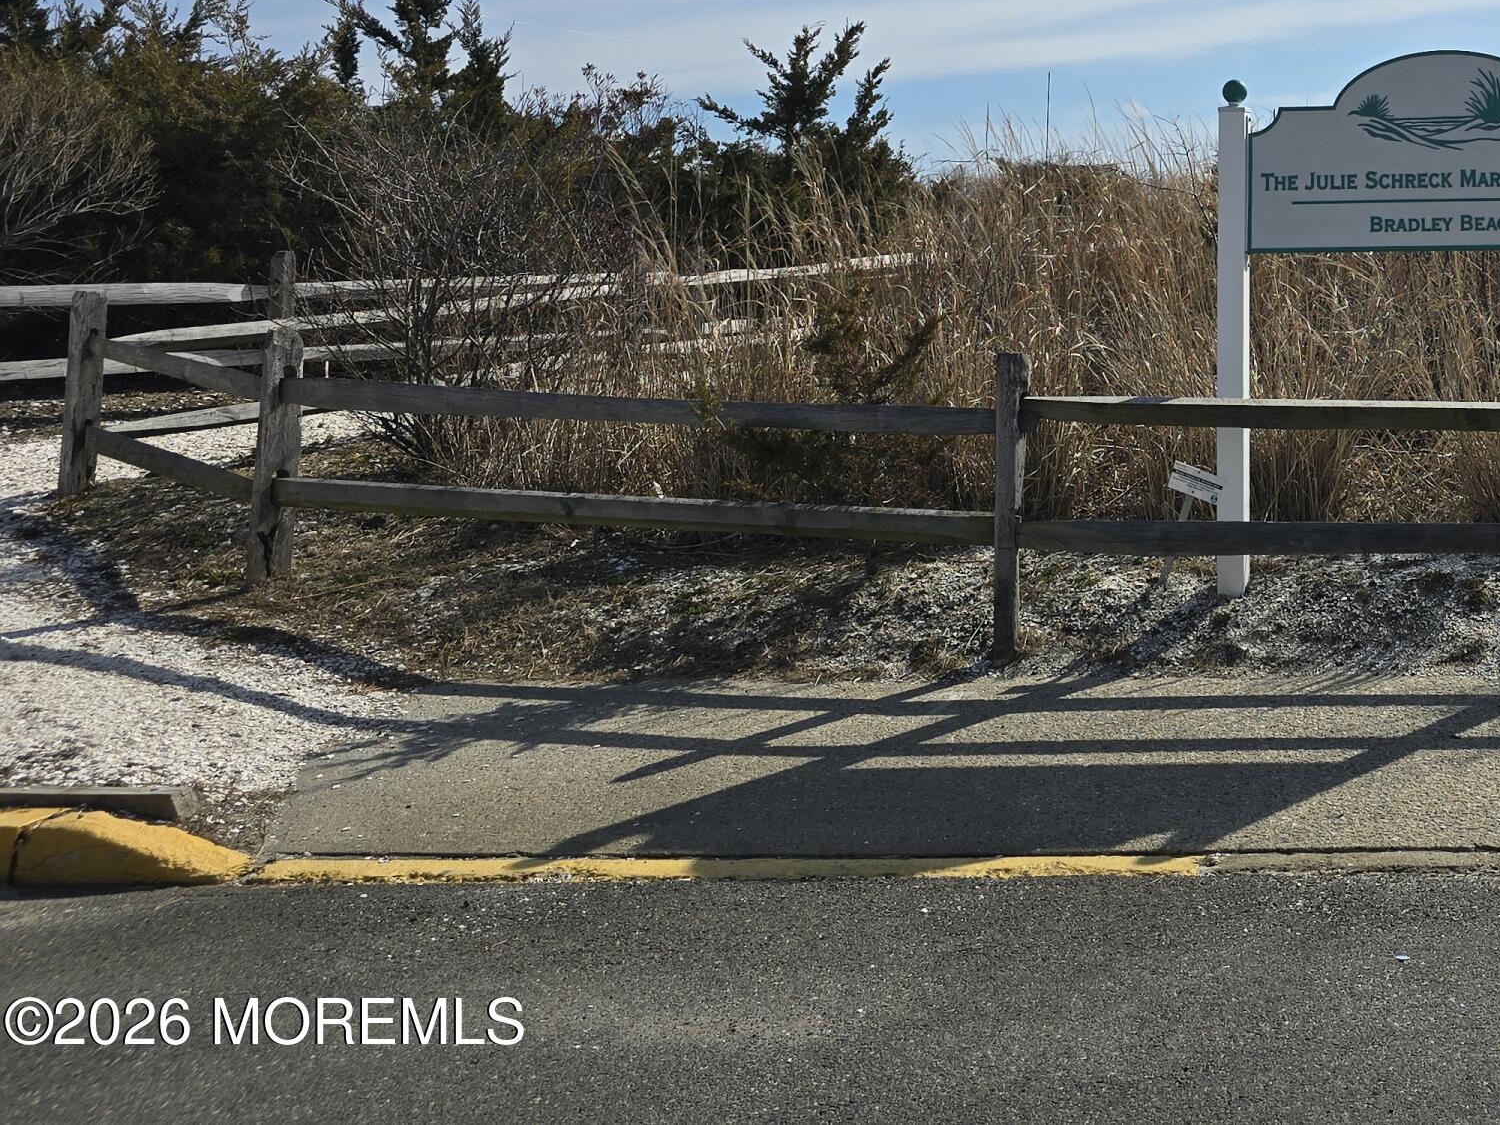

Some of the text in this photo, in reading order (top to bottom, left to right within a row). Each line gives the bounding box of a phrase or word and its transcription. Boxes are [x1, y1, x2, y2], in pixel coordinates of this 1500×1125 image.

[1261, 172, 1299, 191] THE
[1305, 172, 1358, 191] JULIE
[1365, 171, 1453, 189] SCHRECK
[1370, 216, 1453, 233] BRADLEY
